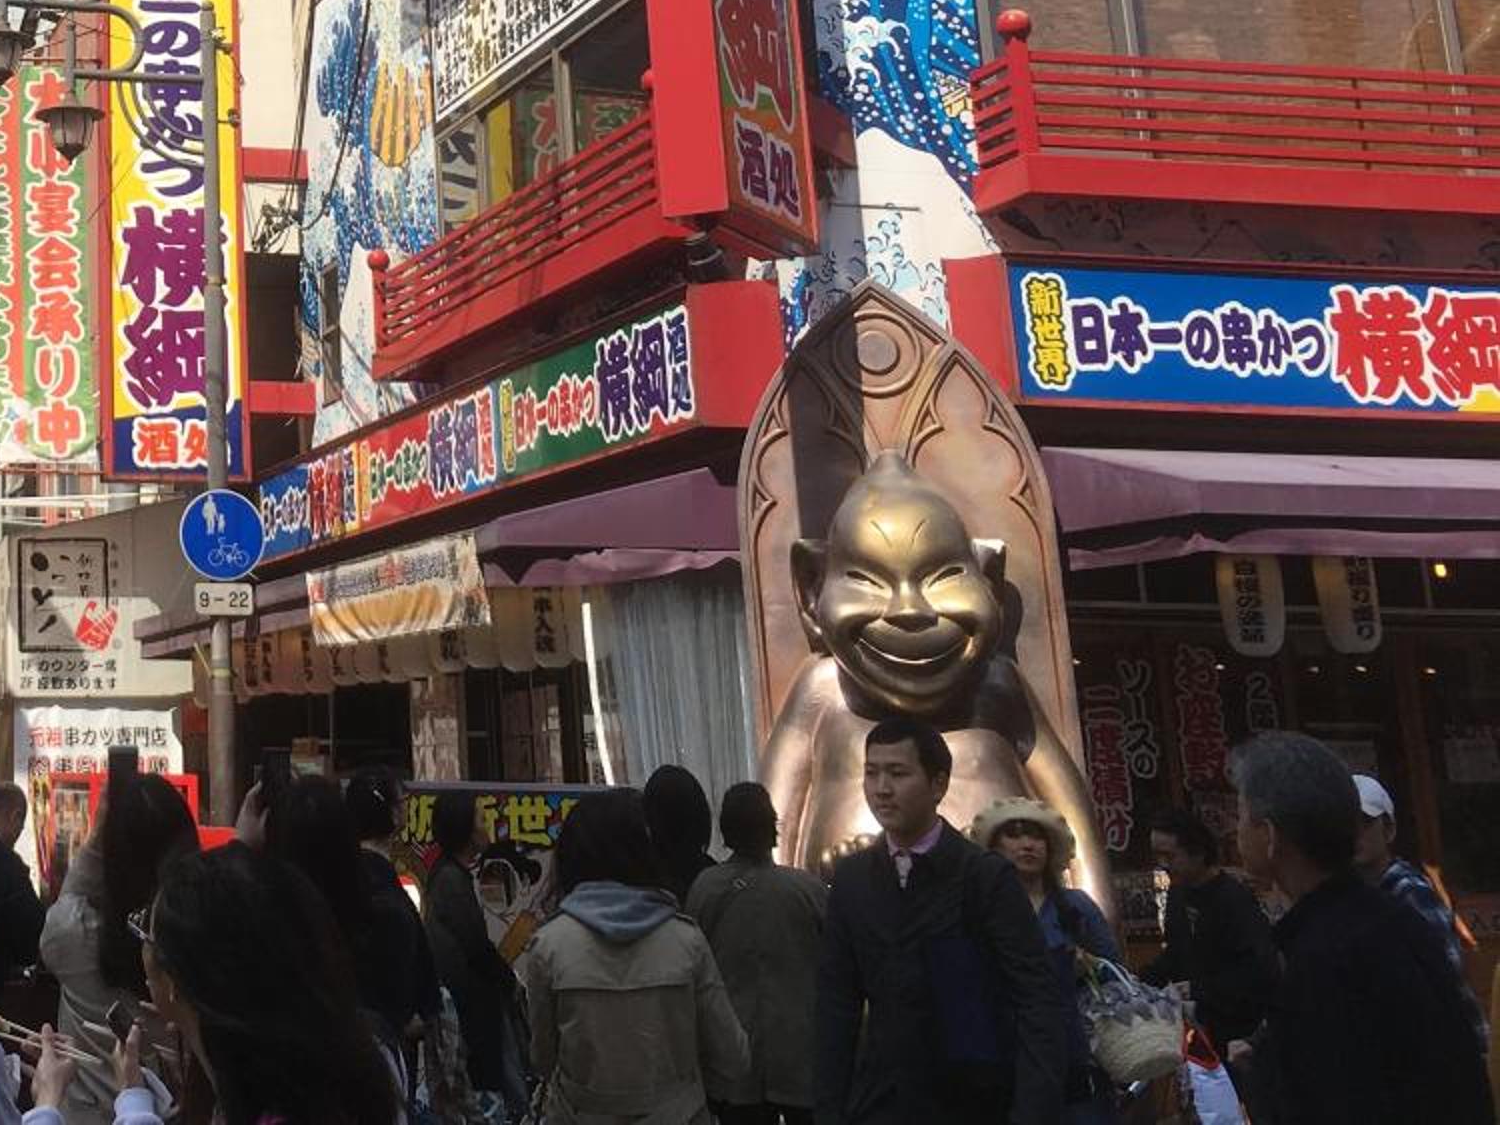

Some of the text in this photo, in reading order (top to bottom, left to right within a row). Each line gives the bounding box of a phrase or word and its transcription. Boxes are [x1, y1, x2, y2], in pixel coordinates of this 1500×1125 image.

[596, 317, 669, 442] 横綱
[1027, 275, 1071, 386] 新世界
[1072, 302, 1328, 373] 日本一の串かつ
[1330, 289, 1500, 404] 横綱
